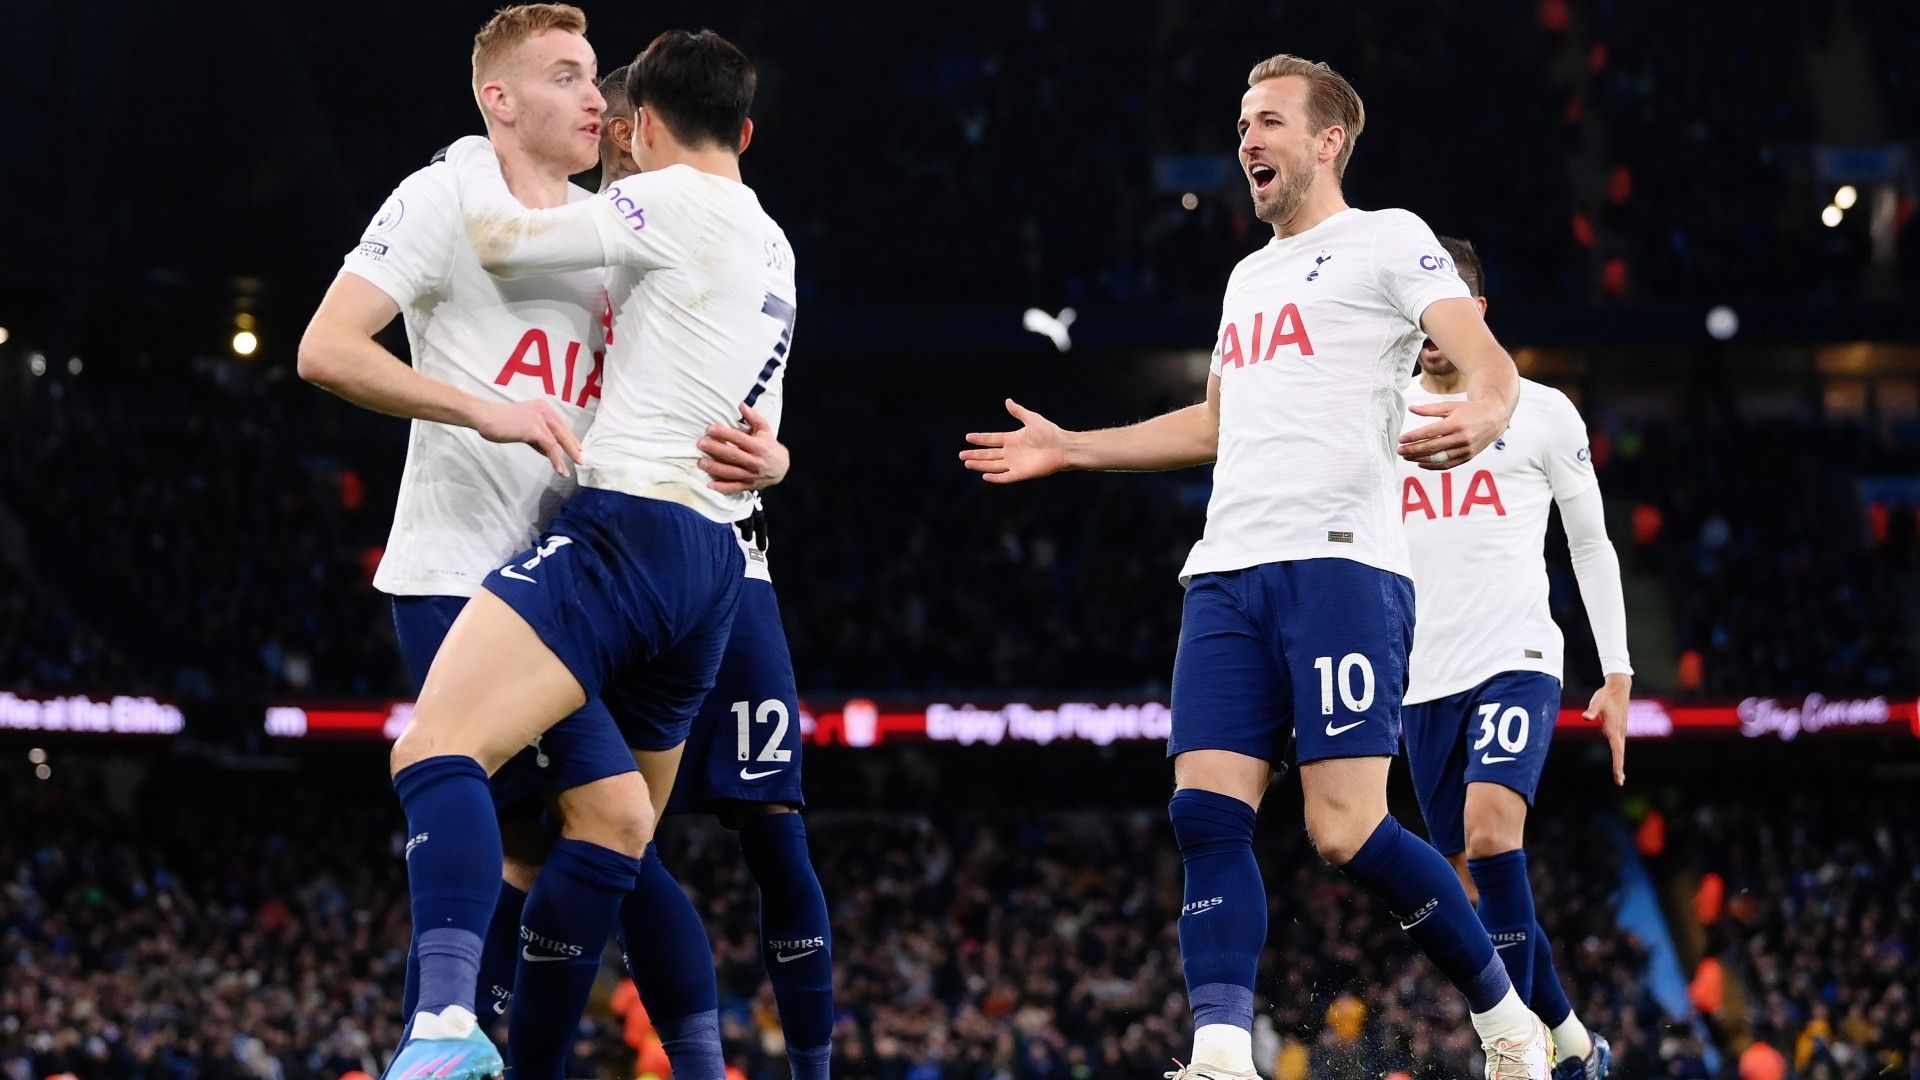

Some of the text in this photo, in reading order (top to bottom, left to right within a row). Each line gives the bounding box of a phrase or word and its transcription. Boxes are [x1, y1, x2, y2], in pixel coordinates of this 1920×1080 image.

[739, 291, 797, 422] 7
[1221, 303, 1314, 369] AIA
[1402, 470, 1506, 524] AIA
[1314, 652, 1375, 716] 10
[730, 699, 792, 762] 12
[1473, 702, 1529, 753] 30
[520, 925, 583, 956] SPURS
[769, 936, 824, 950] SPURS
